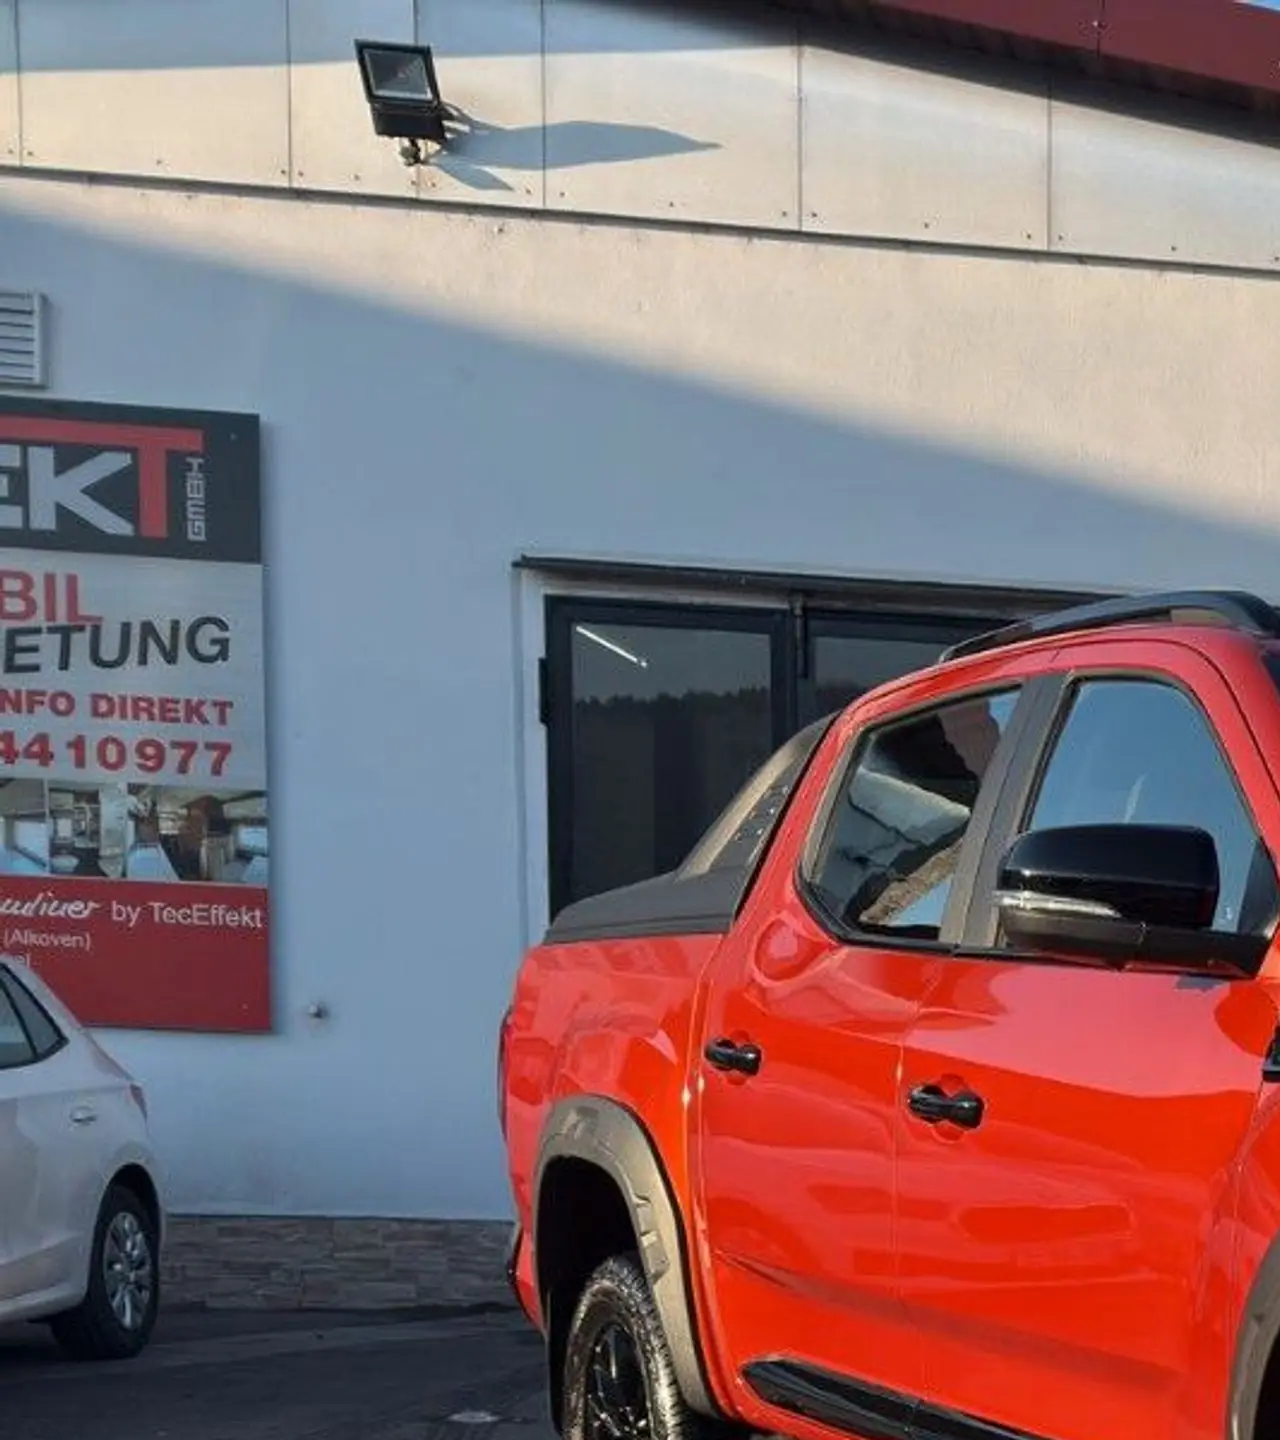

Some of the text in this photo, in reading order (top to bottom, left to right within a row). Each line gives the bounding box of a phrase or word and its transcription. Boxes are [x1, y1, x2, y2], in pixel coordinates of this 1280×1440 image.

[3, 616, 230, 674] ETUNG
[90, 693, 234, 726] DIREKT
[111, 900, 141, 927] by
[150, 902, 263, 928] TecEffekt
